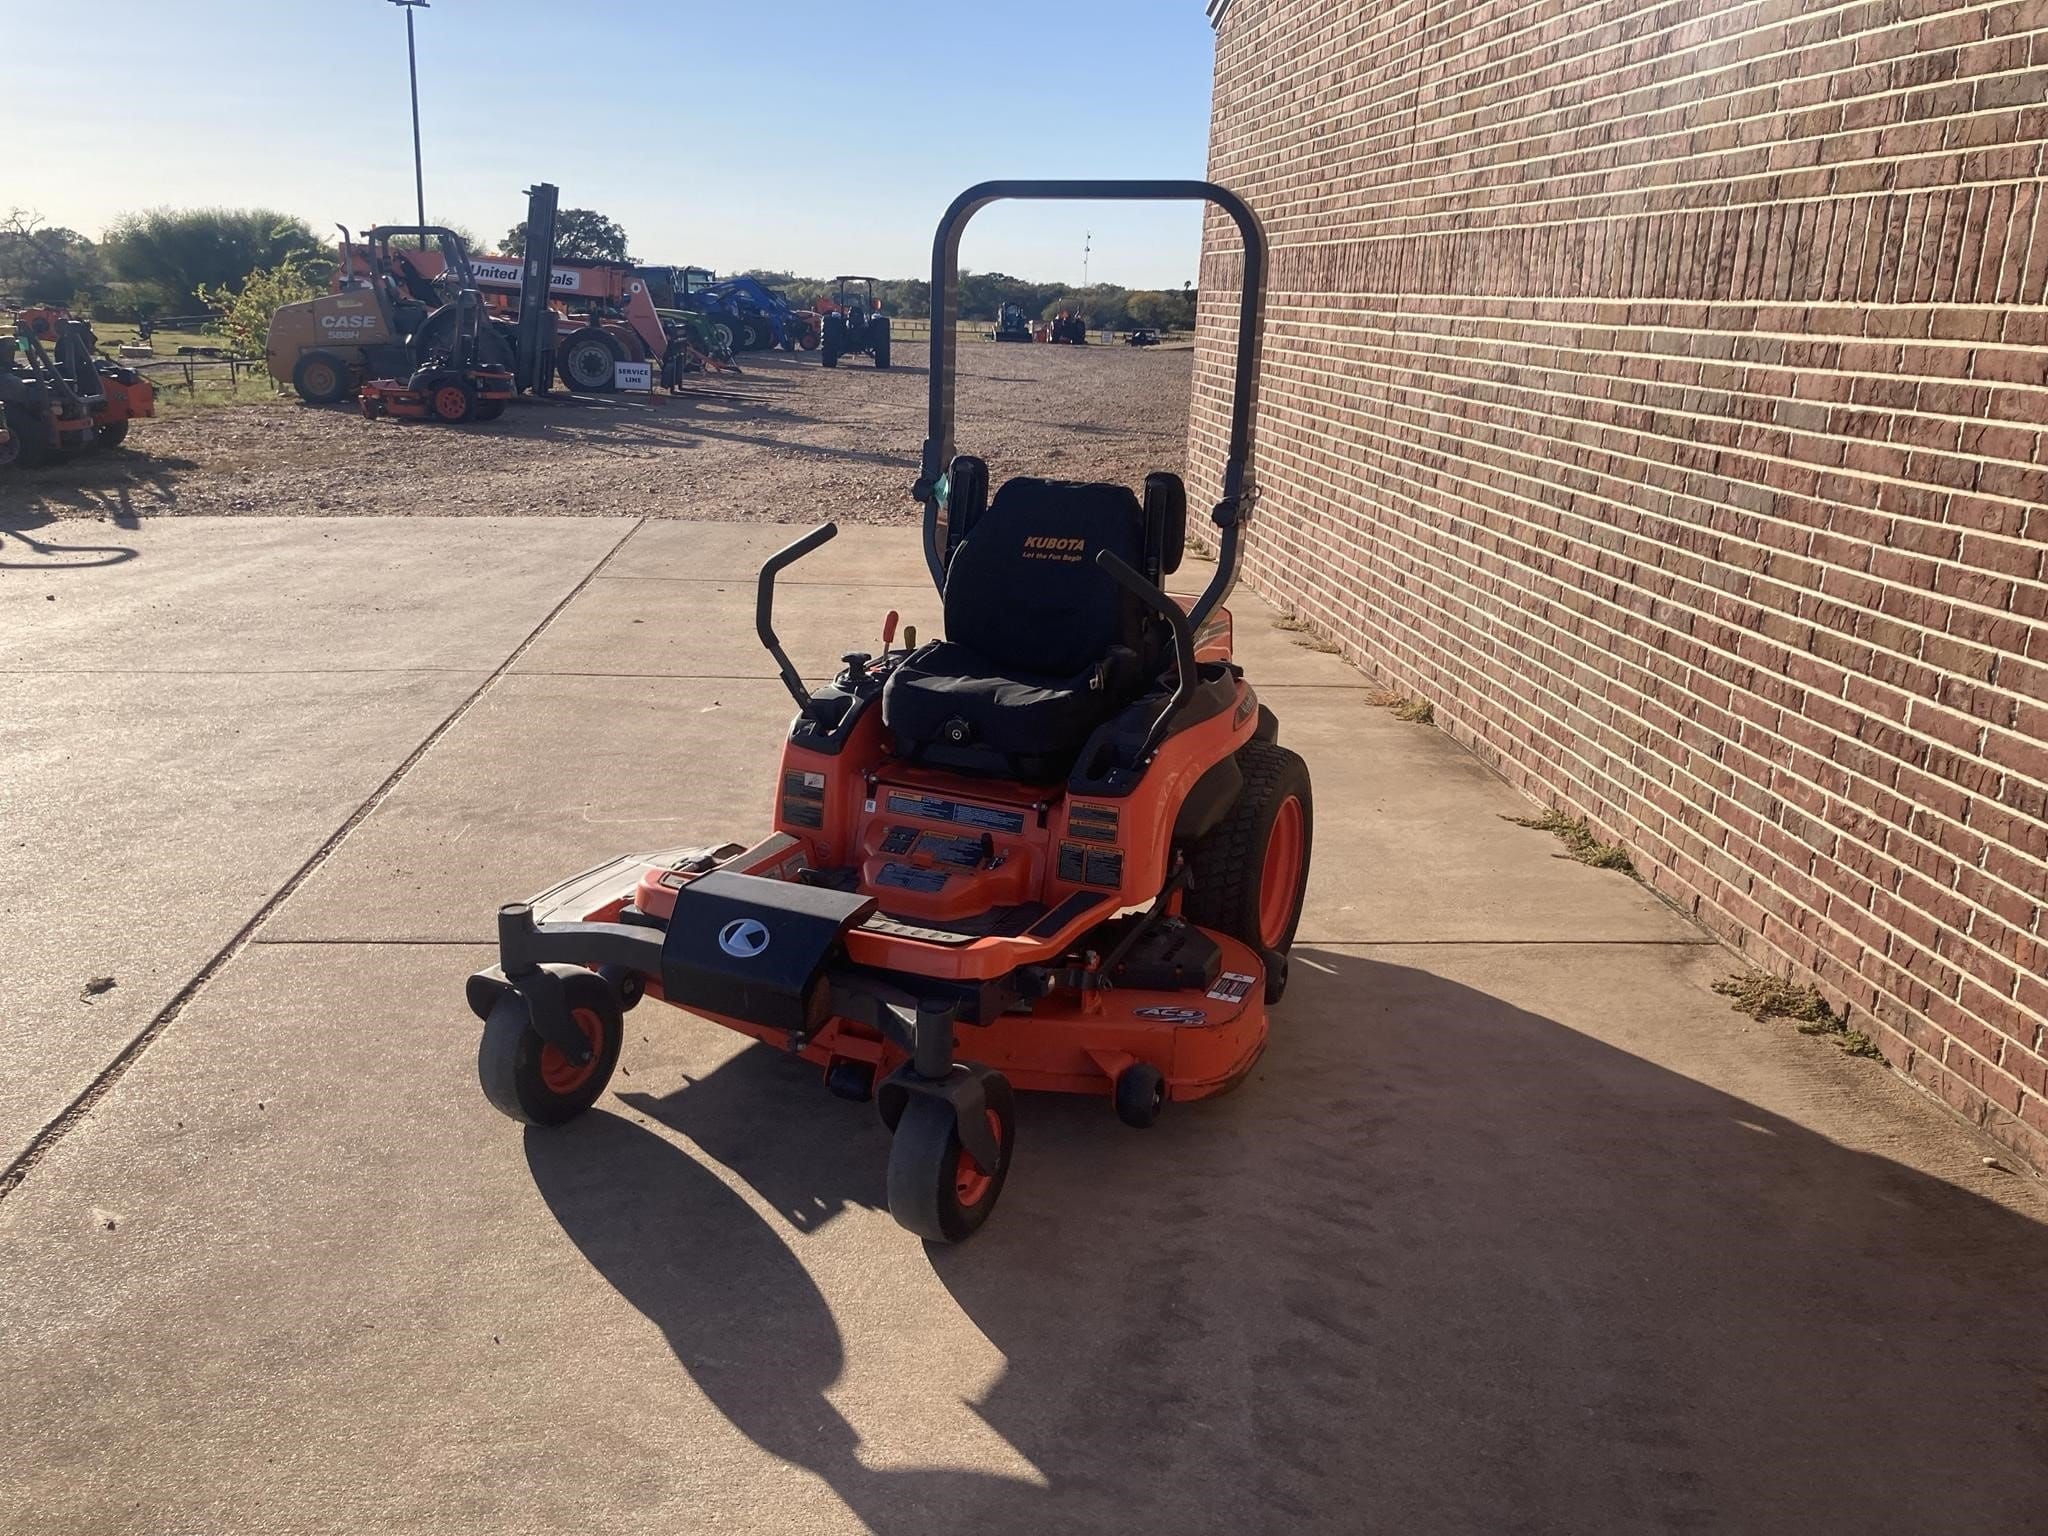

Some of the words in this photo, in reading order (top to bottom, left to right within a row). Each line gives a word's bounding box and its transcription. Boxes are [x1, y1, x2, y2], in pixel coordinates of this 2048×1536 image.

[471, 264, 518, 281] United
[321, 315, 377, 328] CASE
[618, 368, 649, 376] SERVICE
[1024, 536, 1085, 551] KUBOTA
[1143, 1008, 1197, 1017] ACS
